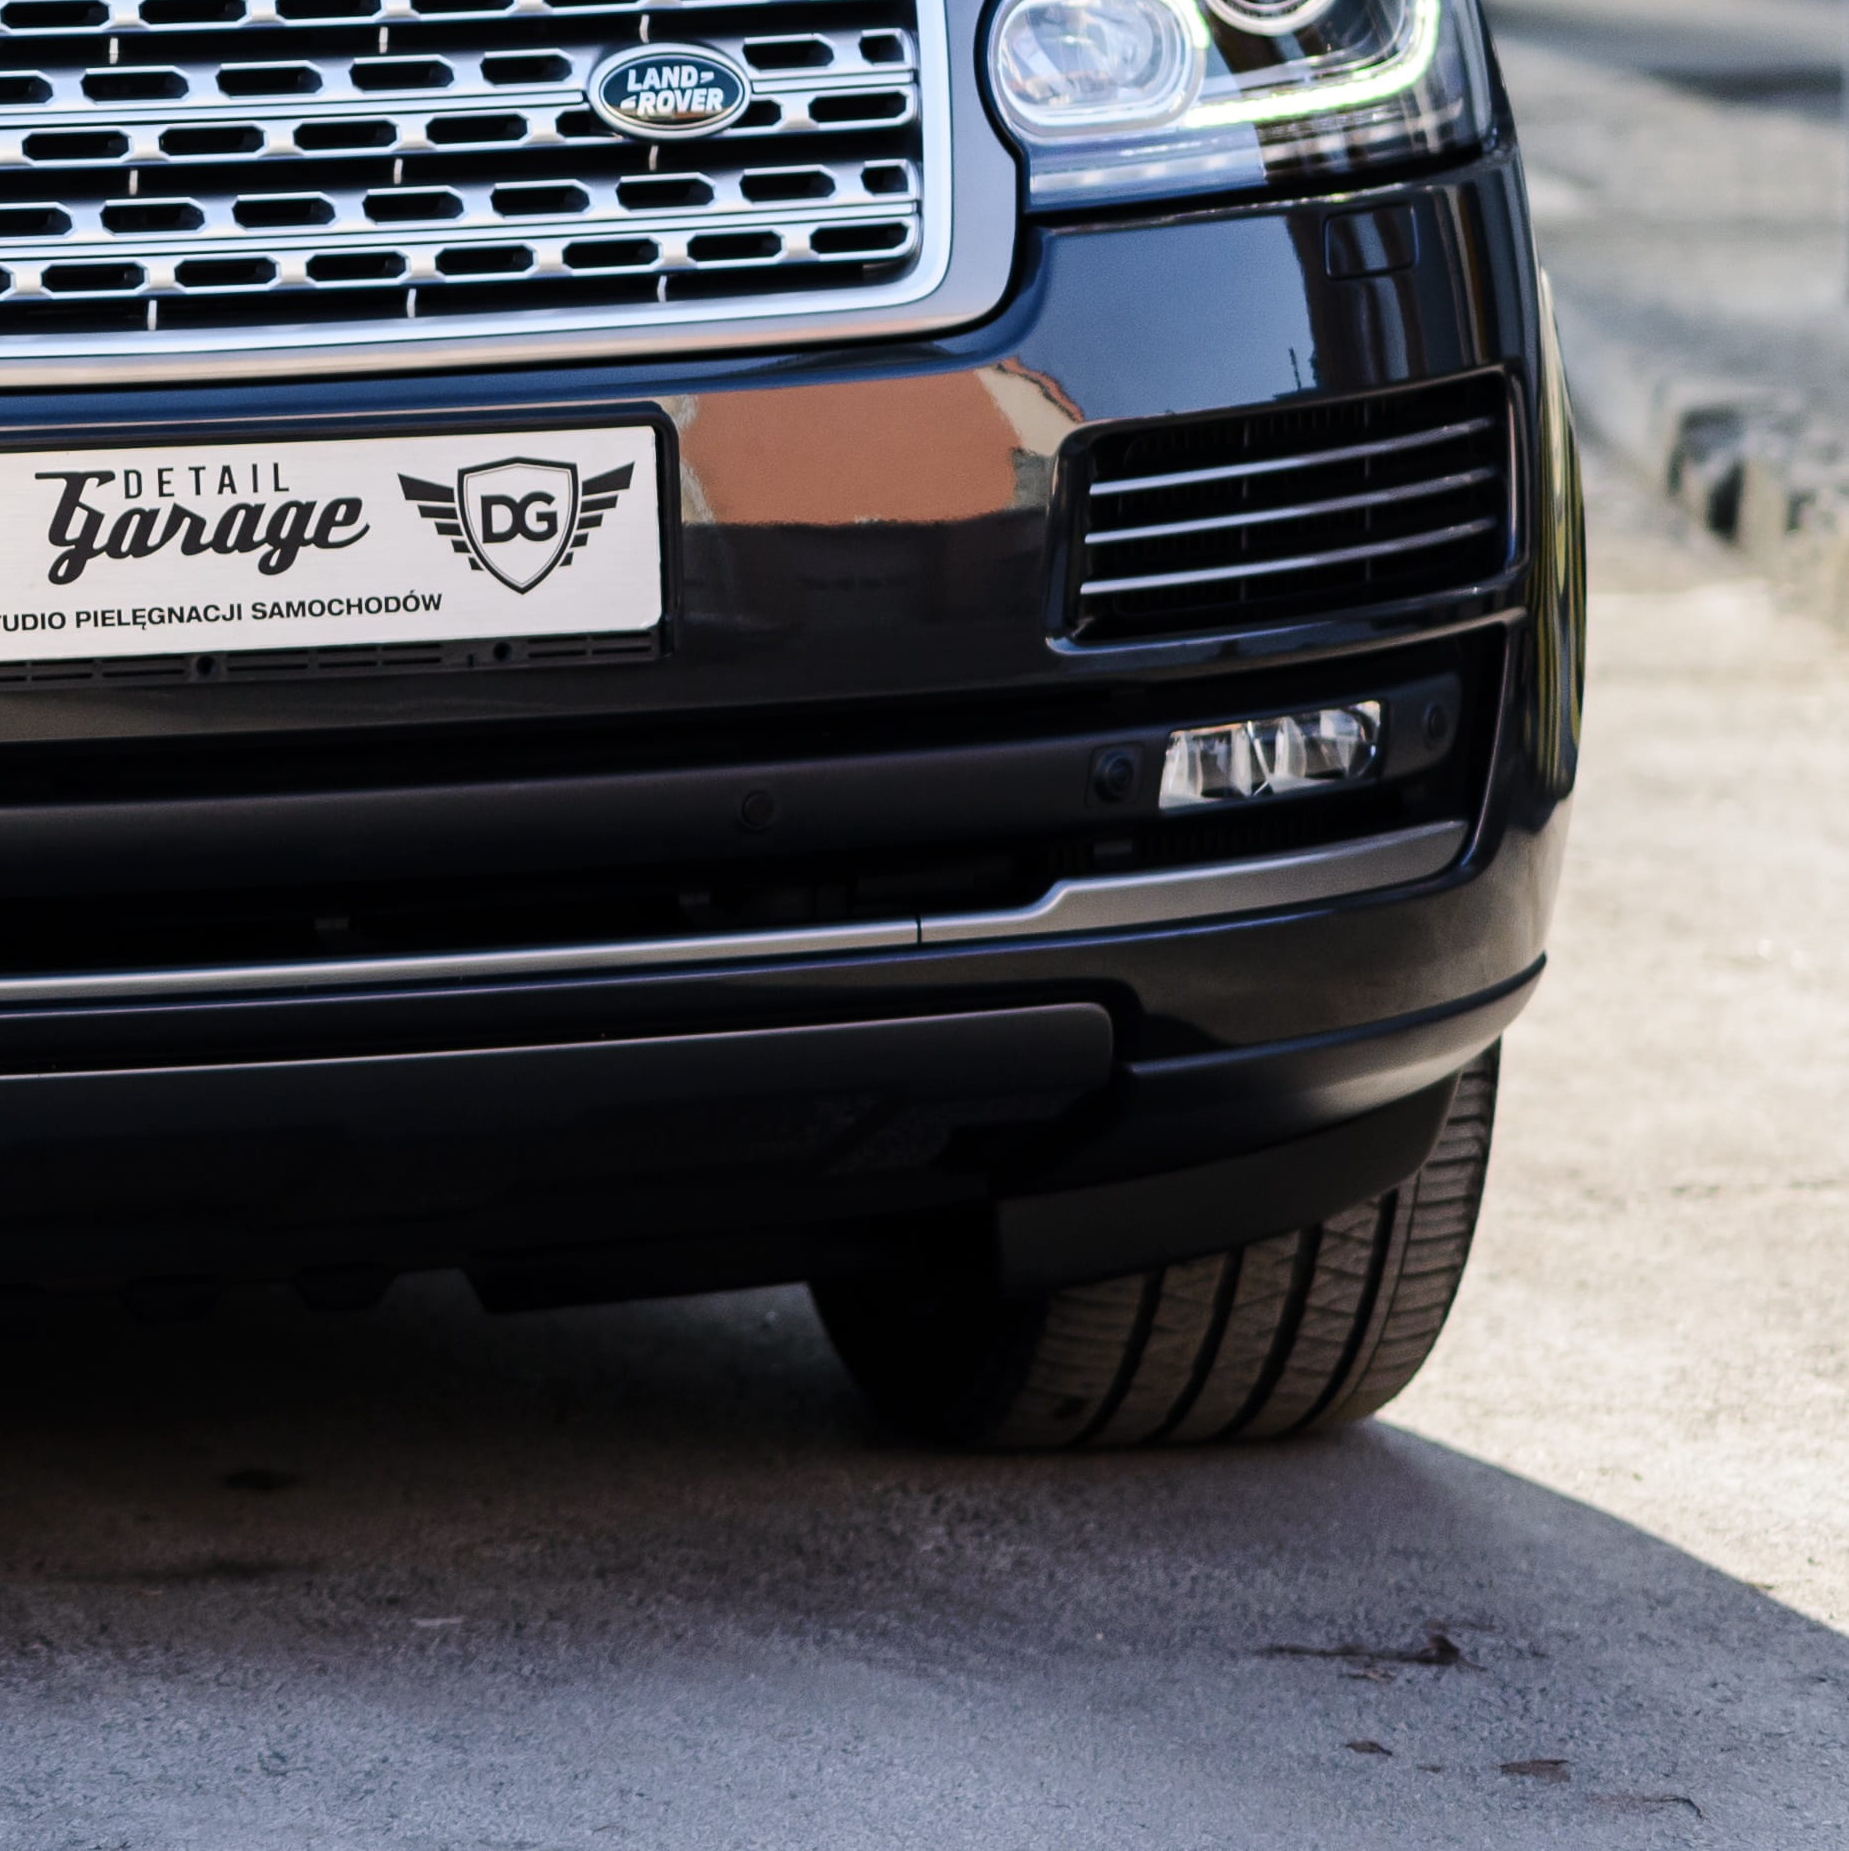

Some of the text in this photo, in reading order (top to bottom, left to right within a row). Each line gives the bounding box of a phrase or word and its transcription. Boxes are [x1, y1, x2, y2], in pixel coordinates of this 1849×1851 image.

[627, 65, 699, 93] LAND
[637, 87, 724, 117] ROVER
[123, 462, 291, 500] DETAIL
[34, 470, 372, 586] Garage
[479, 490, 560, 545] DG
[75, 603, 244, 631] PIELĘGNACJI
[251, 589, 444, 621] SAMOCHODÓW
